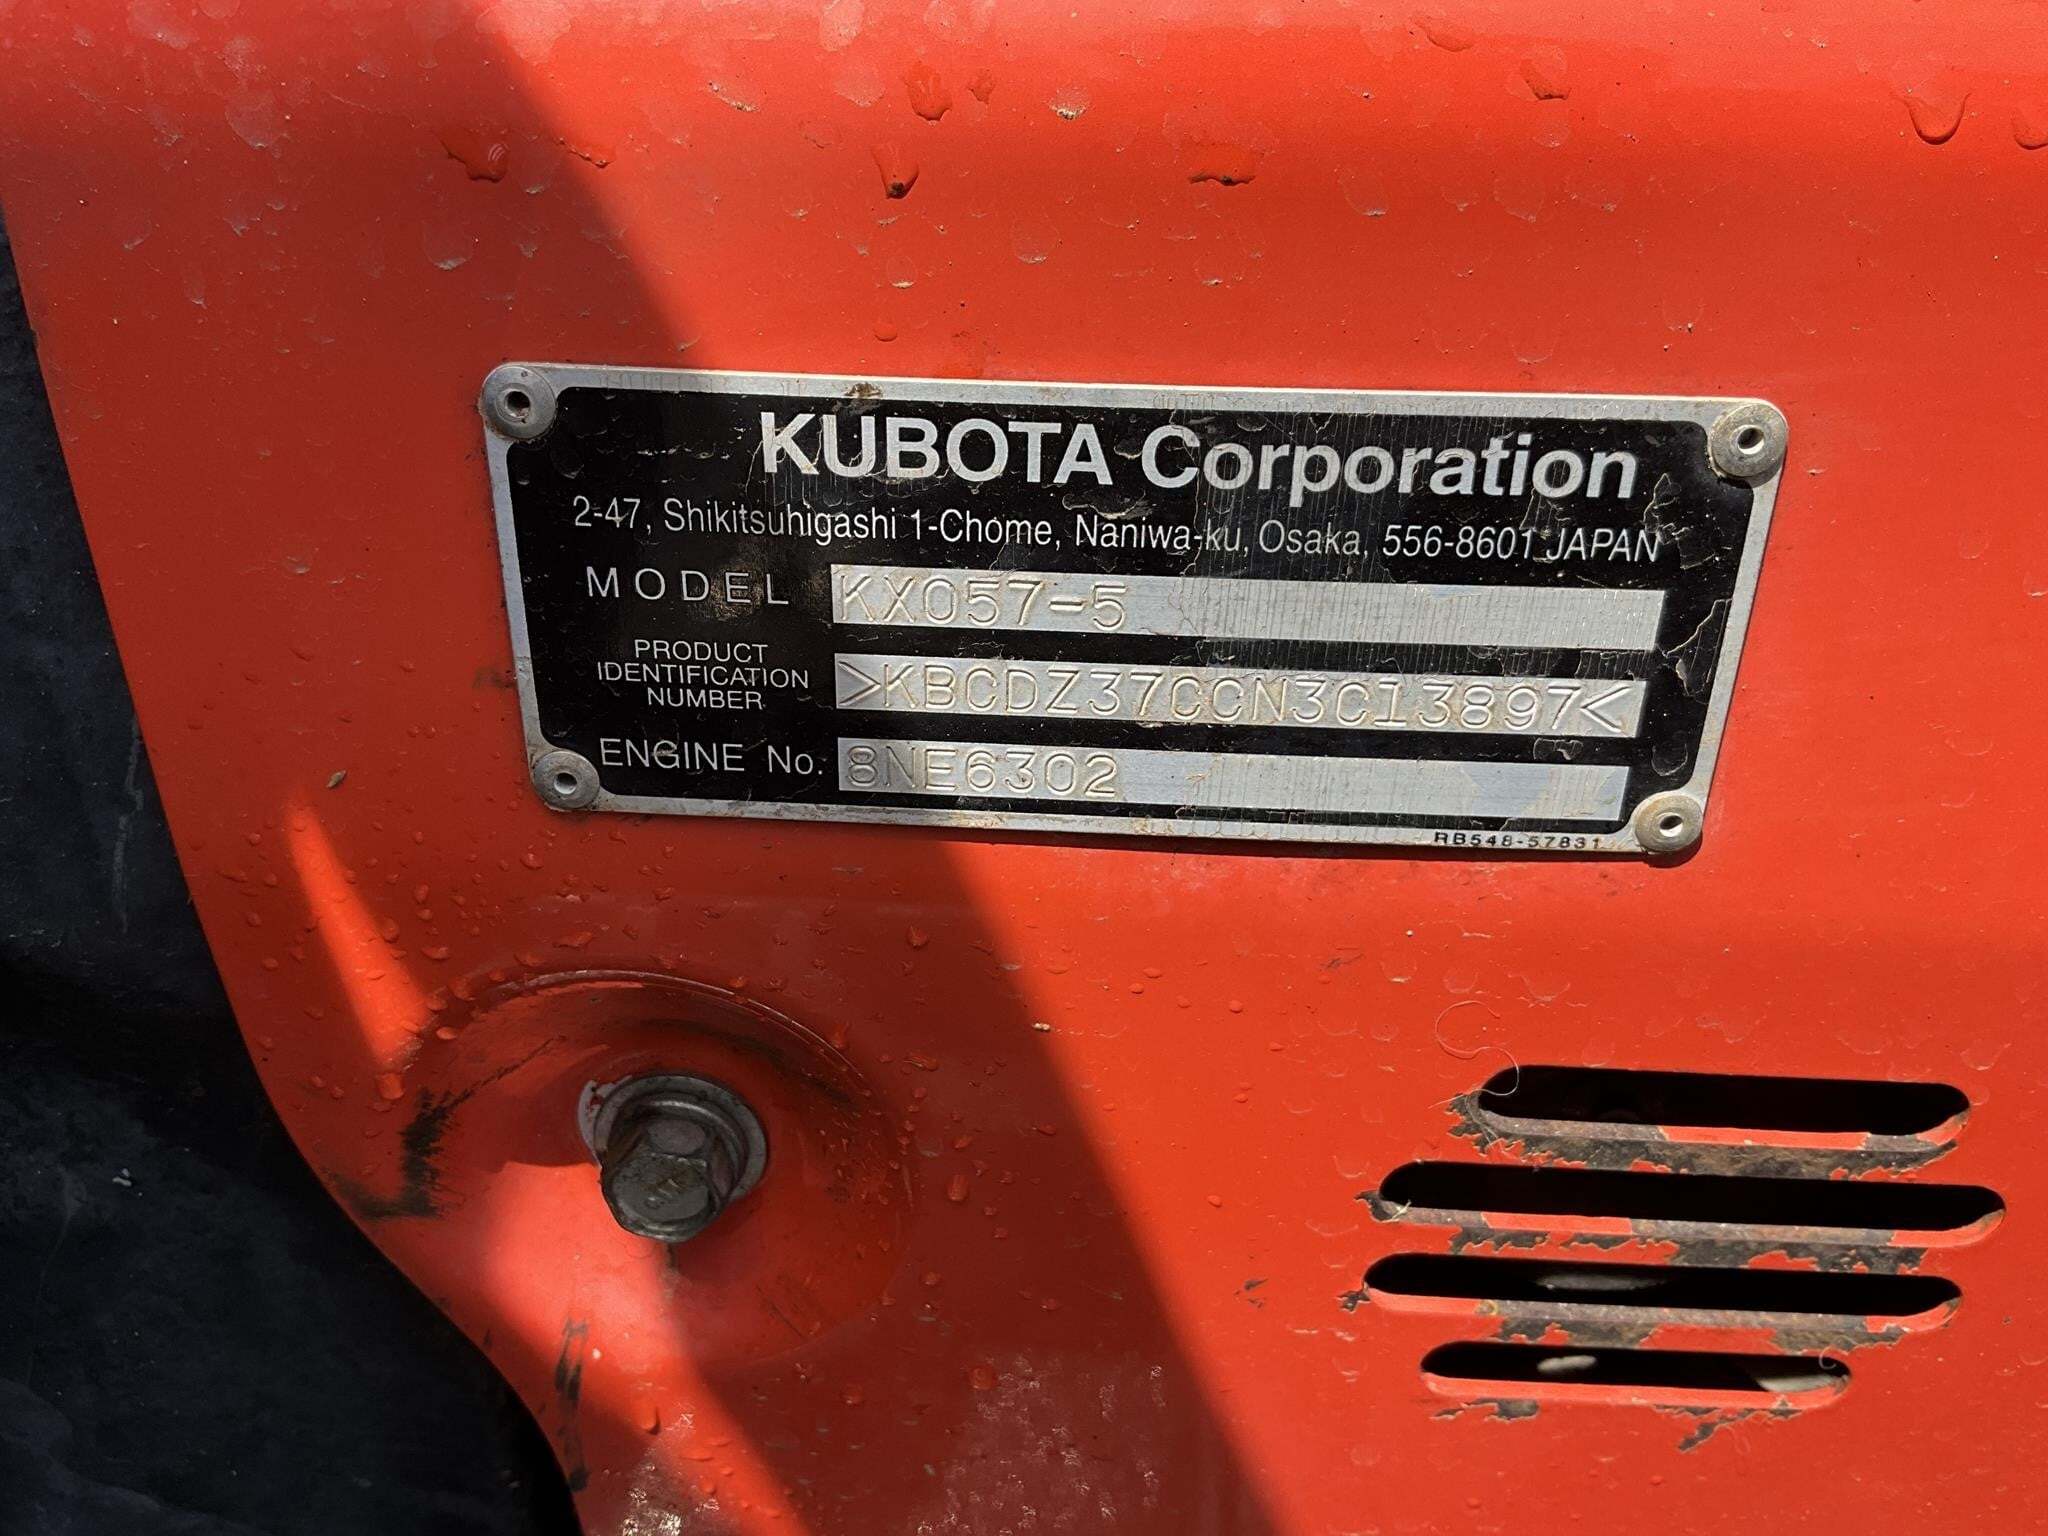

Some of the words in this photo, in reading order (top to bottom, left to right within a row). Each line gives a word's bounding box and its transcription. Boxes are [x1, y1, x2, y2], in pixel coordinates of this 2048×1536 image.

[760, 411, 1114, 486] KUBOTA
[1141, 424, 1638, 508] Corporation
[572, 495, 653, 534] 2-47,
[663, 497, 898, 547] Shikitsuhigashi
[909, 510, 1061, 550] 1-Chome,
[1074, 512, 1250, 558] Naniwa-ku,
[1258, 518, 1371, 557] Osaka,
[1382, 524, 1535, 561] 556-8601
[1545, 527, 1662, 564] JAPAN
[586, 566, 790, 606] MODEL
[836, 572, 1128, 632] KX057-5
[634, 639, 768, 664] PRODUCT
[597, 661, 810, 690] IDENTIFICATION
[647, 687, 764, 710] NUMBER
[599, 737, 747, 773] ENGINE
[767, 745, 824, 776] No.
[844, 744, 1120, 799] 8NE6302
[1433, 831, 1602, 850] RB548-57831
